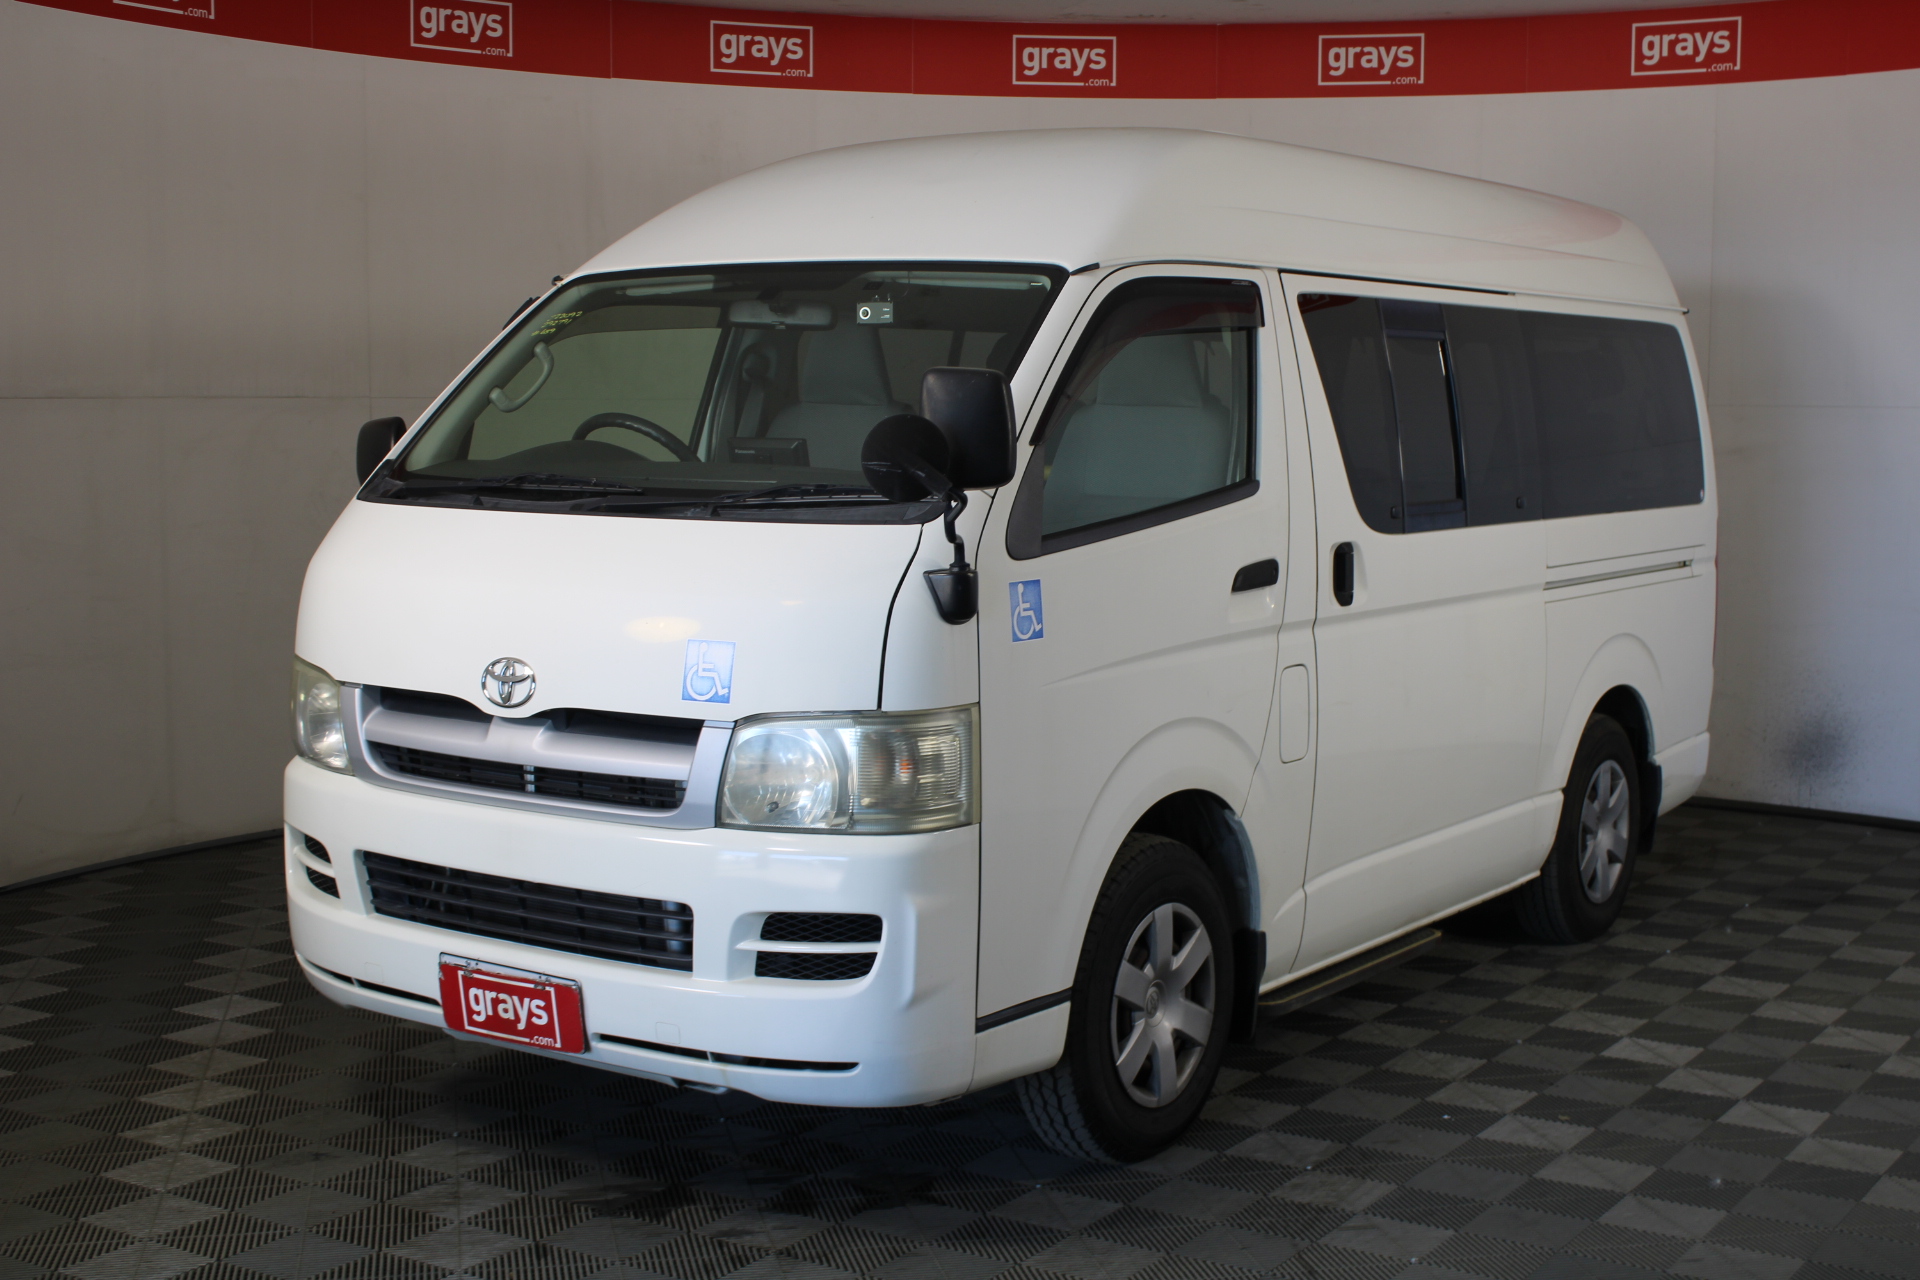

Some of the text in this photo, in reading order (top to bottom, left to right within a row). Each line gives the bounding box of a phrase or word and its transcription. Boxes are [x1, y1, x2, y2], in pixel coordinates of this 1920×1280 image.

[184, 7, 208, 19] .com
[420, 6, 503, 43] grays
[482, 47, 506, 57] .com
[720, 33, 804, 66] grays
[1641, 30, 1731, 66] grays
[1022, 47, 1107, 77] grays
[1328, 45, 1415, 76] grays
[782, 68, 807, 77] .com
[1707, 62, 1733, 72] .com
[1085, 78, 1110, 87] .com
[1392, 76, 1417, 85] .com
[468, 987, 549, 1031] grays
[530, 1035, 555, 1047] .com
